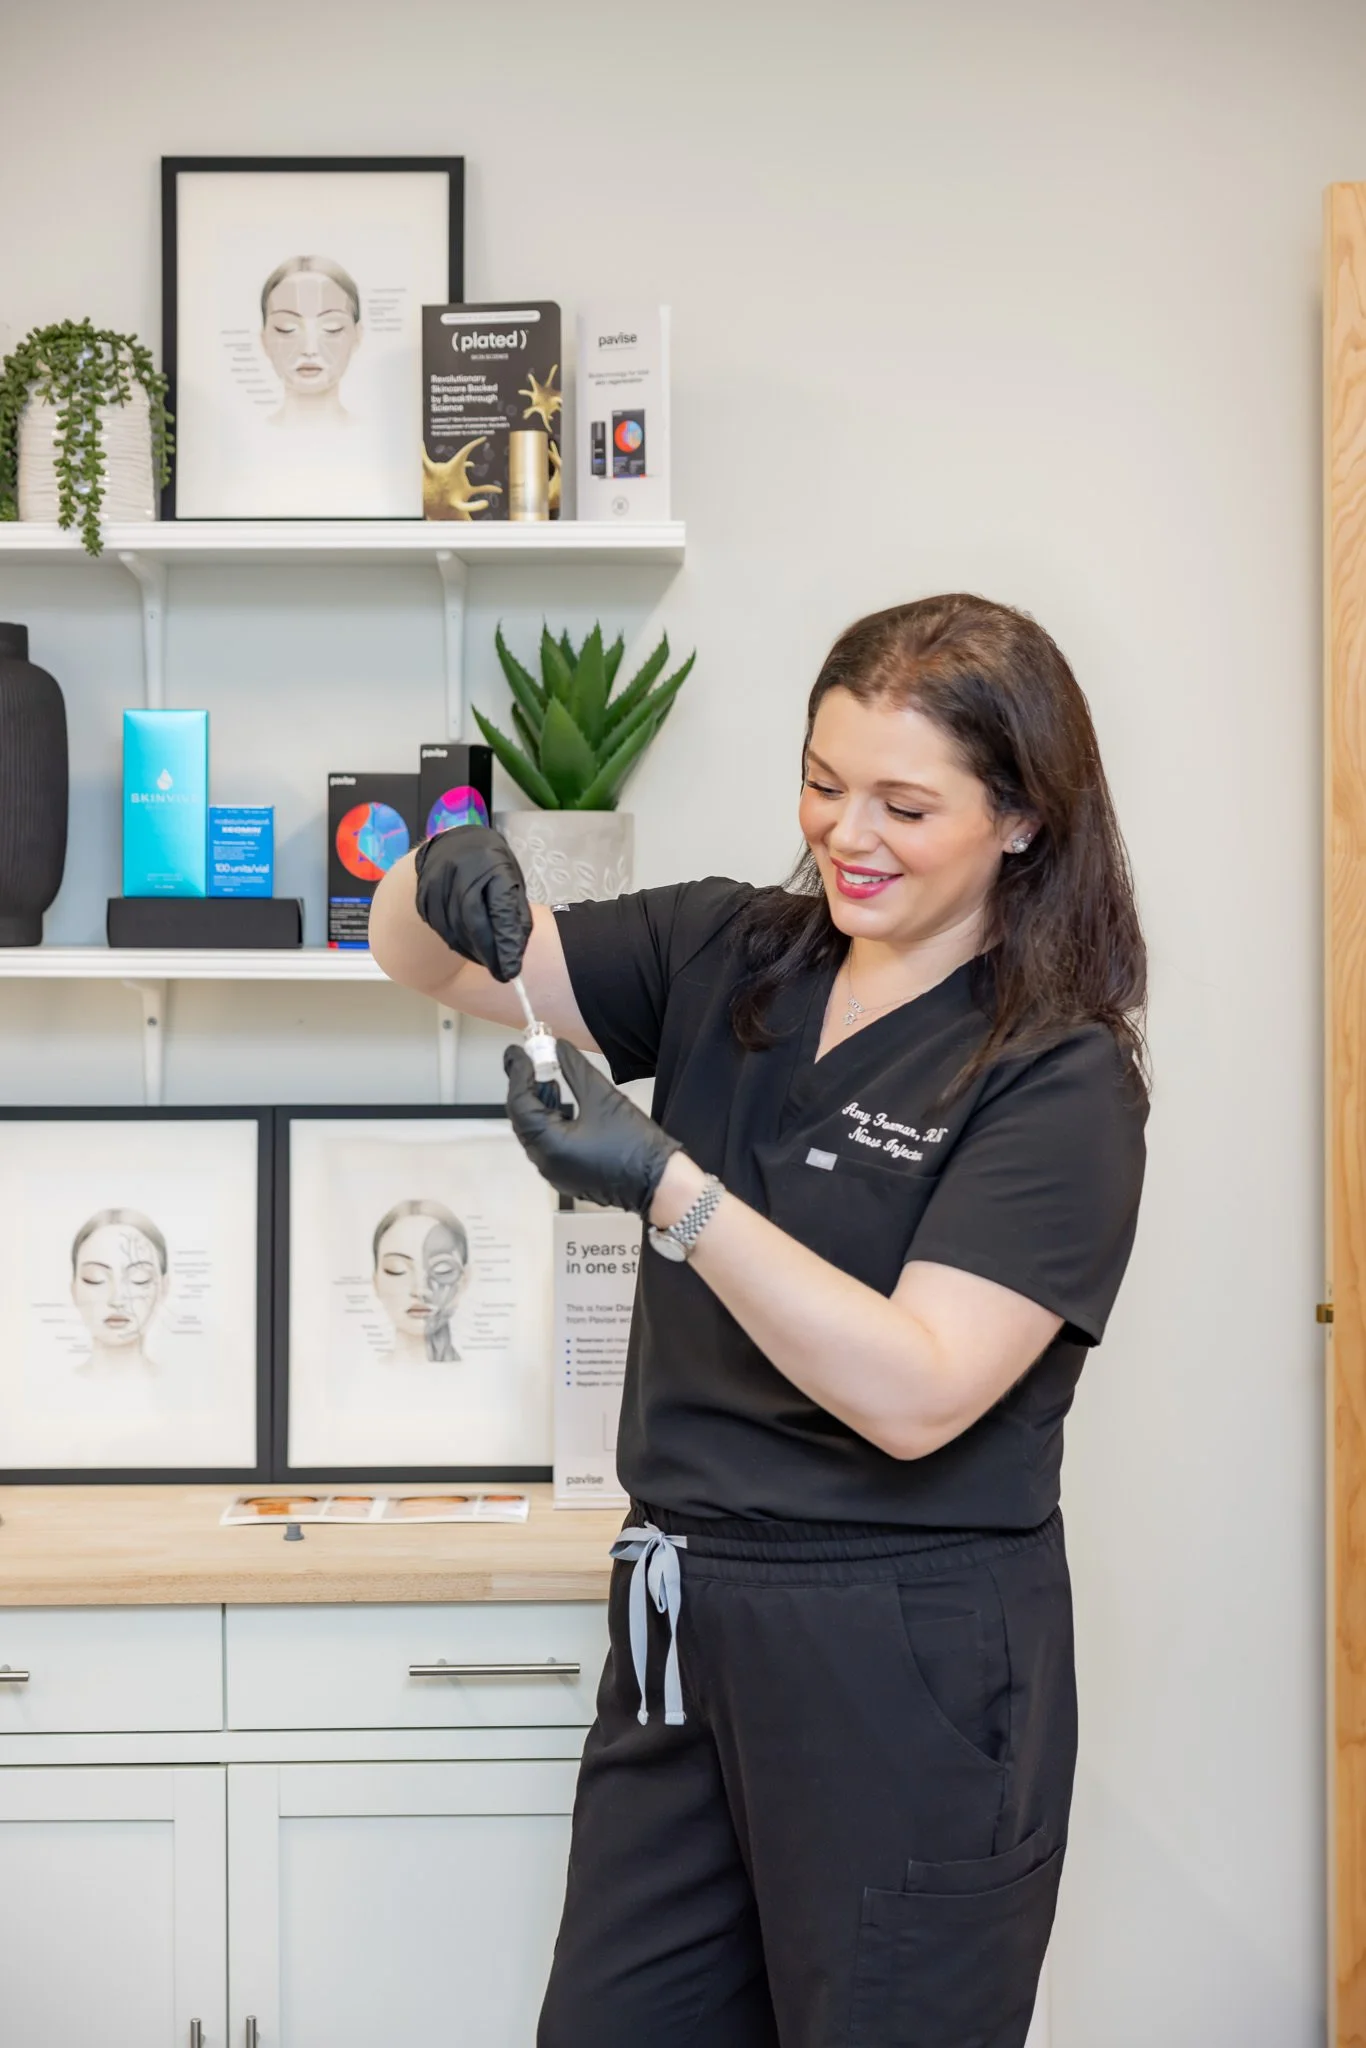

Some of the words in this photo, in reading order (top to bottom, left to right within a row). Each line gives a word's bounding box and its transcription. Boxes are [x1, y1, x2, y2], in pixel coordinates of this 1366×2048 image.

[598, 331, 638, 348] pavise
[430, 374, 487, 384] Revolutionary
[430, 384, 467, 393] Skincare
[467, 383, 499, 392] Backed
[430, 394, 442, 404] by
[442, 393, 499, 405] Breakthrough
[430, 403, 464, 412] Science
[215, 863, 231, 873] 100
[841, 1102, 871, 1125] Amy
[848, 1126, 882, 1148] Nurse
[566, 1241, 577, 1257] 5
[581, 1243, 627, 1260] years
[566, 1260, 581, 1274] in
[586, 1262, 617, 1274] one
[622, 1261, 637, 1274] st
[566, 1473, 605, 1486] pavise
